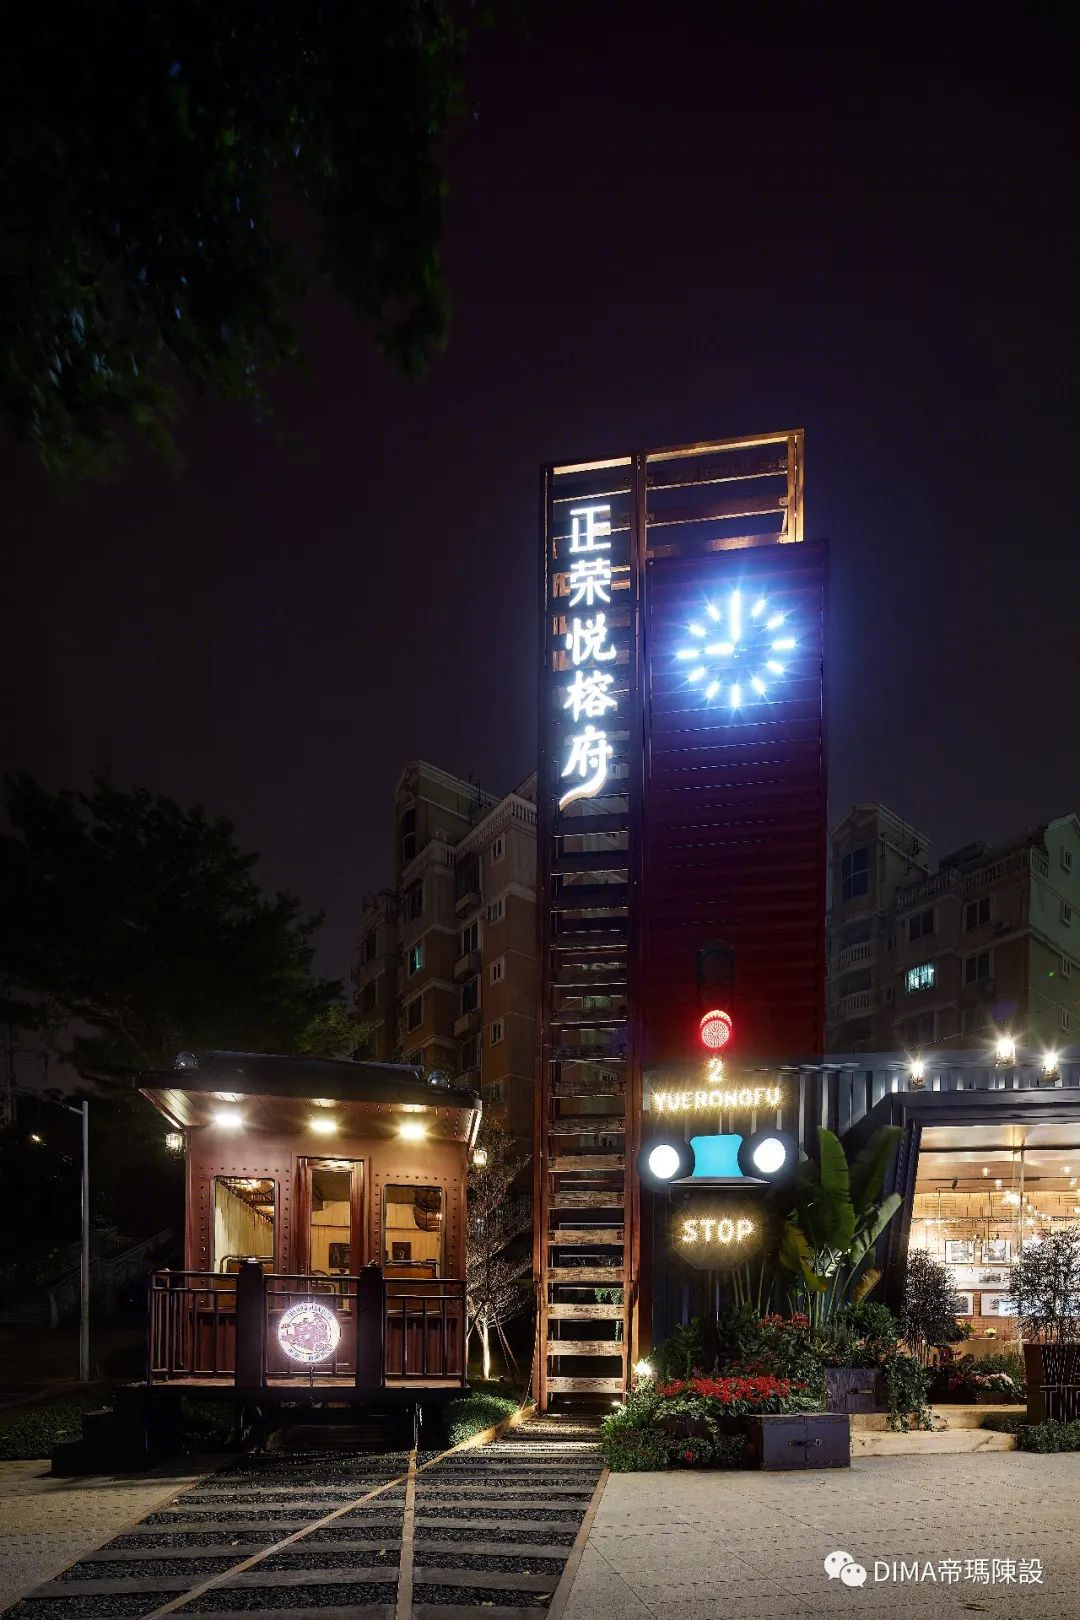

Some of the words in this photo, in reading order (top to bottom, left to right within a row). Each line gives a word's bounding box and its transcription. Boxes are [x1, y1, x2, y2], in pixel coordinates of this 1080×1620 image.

[559, 504, 617, 811] 正荣悦榕府
[707, 1056, 725, 1083] 2
[652, 1086, 782, 1112] YUERONGFU
[681, 1217, 755, 1246] STOP
